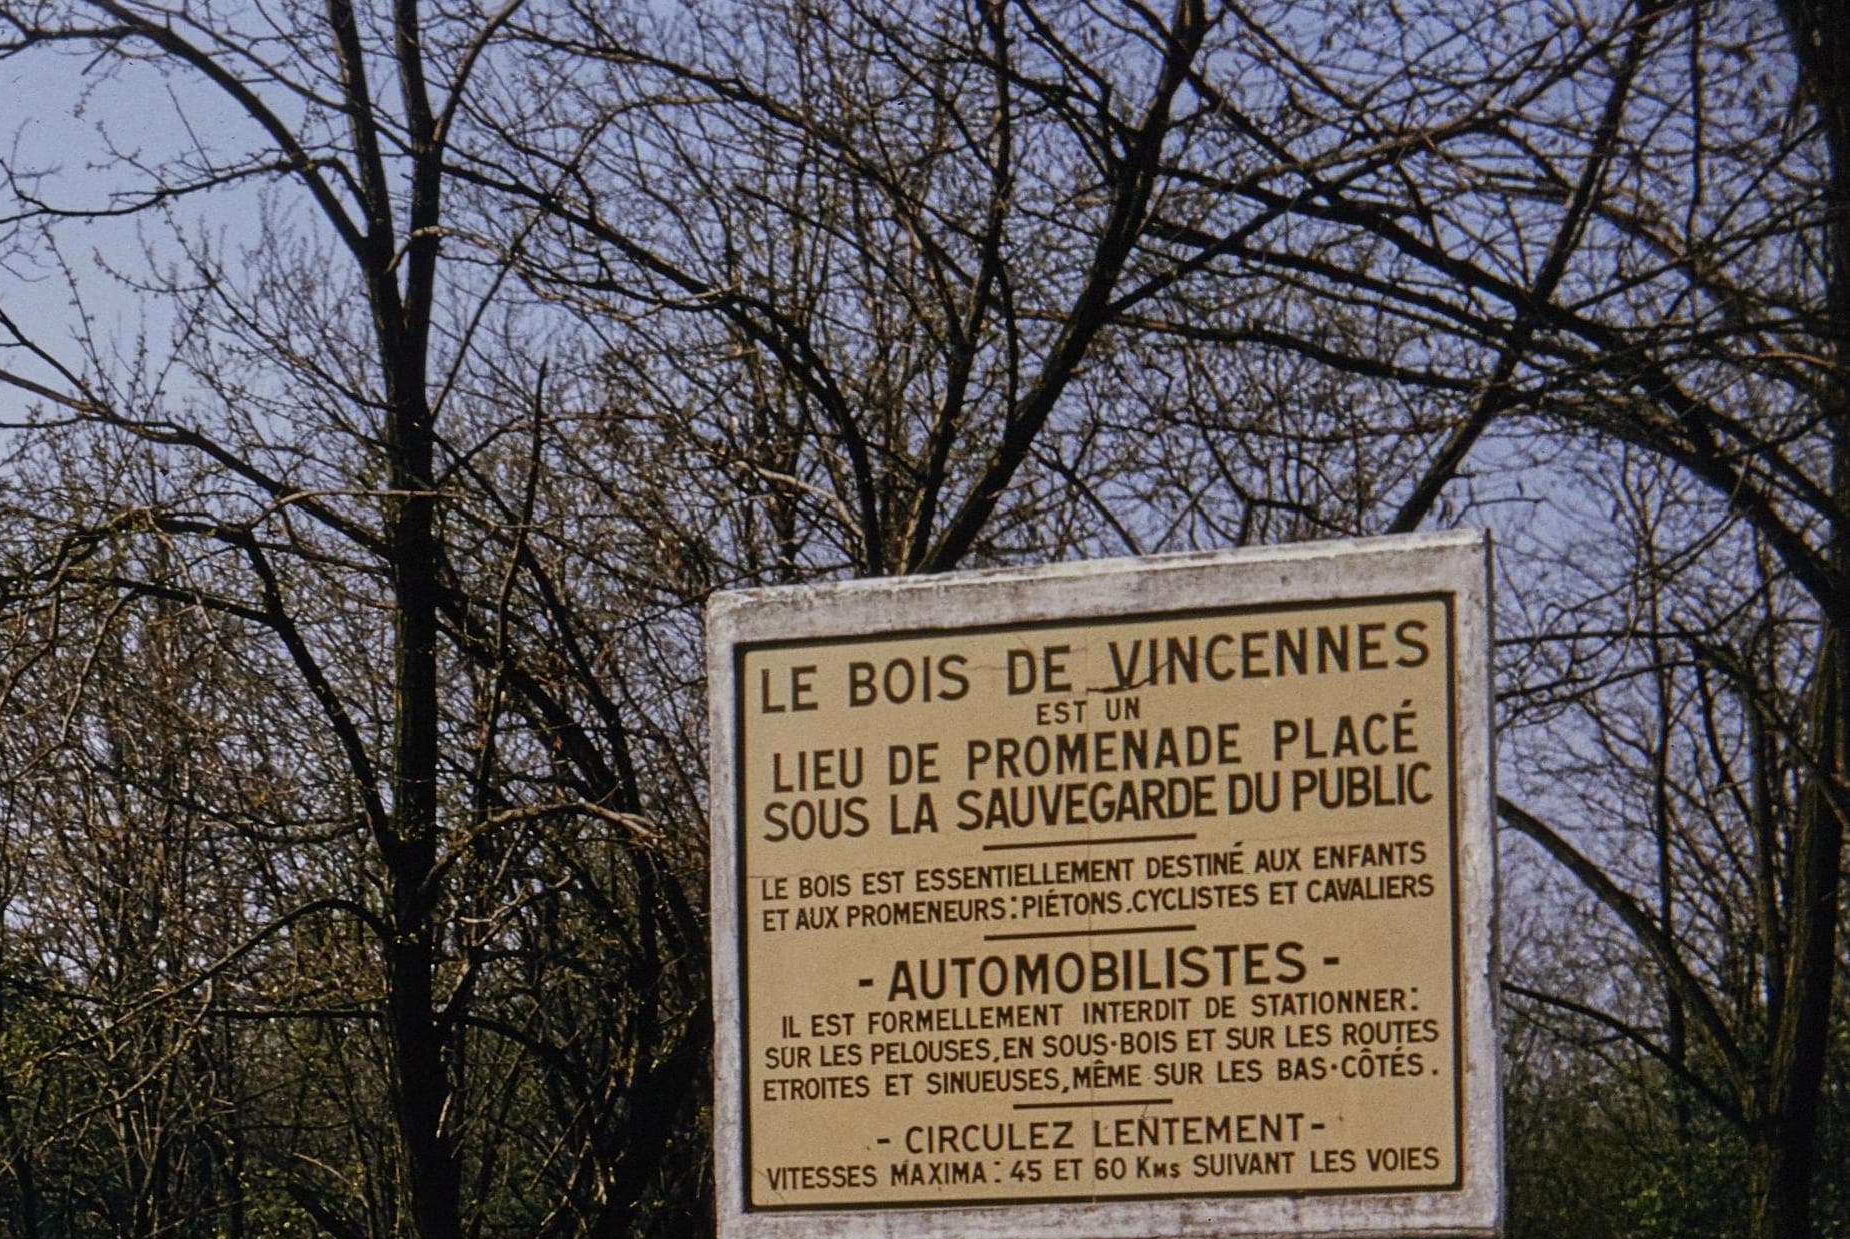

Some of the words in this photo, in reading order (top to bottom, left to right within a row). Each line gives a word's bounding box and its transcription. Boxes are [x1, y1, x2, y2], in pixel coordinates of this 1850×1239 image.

[760, 665, 819, 714] LE
[848, 653, 971, 708] BOIS
[1006, 644, 1072, 696] DE
[1108, 620, 1429, 690] VINCENNES
[1036, 700, 1088, 726] EST
[1105, 697, 1140, 722] UN
[772, 747, 863, 793] LIEU
[888, 741, 940, 786] DE
[967, 722, 1242, 781] PROMENADE
[1273, 698, 1419, 761] PLACÉ
[763, 796, 870, 843] SOUS
[890, 792, 939, 835] LA
[956, 775, 1218, 831] SAUVEGARDE
[1227, 770, 1281, 816] DU
[1292, 761, 1433, 812] PUBLIC
[761, 877, 789, 901] LE
[798, 874, 851, 899] BOIS
[862, 871, 905, 895] EST
[915, 858, 1134, 893] ESSENTIELLEMENT
[1145, 840, 1244, 880] DESTINÉ
[1254, 847, 1302, 874] AUX
[1313, 840, 1427, 870] ENFANTS
[762, 908, 789, 932] ET
[795, 906, 839, 931] AUX
[1132, 881, 1260, 913] CYCLISTES
[1268, 881, 1299, 905] ET
[1306, 873, 1435, 903] CAVALIERS
[887, 941, 1307, 1002] AUTOMOBILISTES
[765, 1046, 812, 1070] SUR
[819, 1043, 863, 1067] LES
[1003, 1036, 1034, 1060] EN
[1186, 1028, 1217, 1052] ET
[1225, 1025, 1275, 1051] SUR
[1285, 1023, 1332, 1048] LES
[1342, 1019, 1439, 1045] ROUTES
[781, 1015, 801, 1039] IL
[811, 1013, 855, 1037] EST
[867, 1003, 1063, 1035] FORMELLEMENT
[1083, 998, 1192, 1025] INTERDIT
[1205, 996, 1236, 1019] DE
[763, 1075, 870, 1101] ETROITES
[884, 1073, 913, 1097] ET
[1072, 1060, 1142, 1089] MÊME
[1153, 1062, 1204, 1087] SUR
[1216, 1059, 1263, 1084] LES
[905, 1121, 1075, 1155] CIRCULEZ
[766, 1165, 878, 1191] VITESSES
[1009, 1159, 1043, 1183] 45
[1054, 1158, 1083, 1182] ET
[1093, 1156, 1127, 1181] 60
[1193, 1151, 1295, 1178] SUIVANT
[1310, 1149, 1357, 1174] LES
[1366, 1147, 1440, 1172] VOIES
